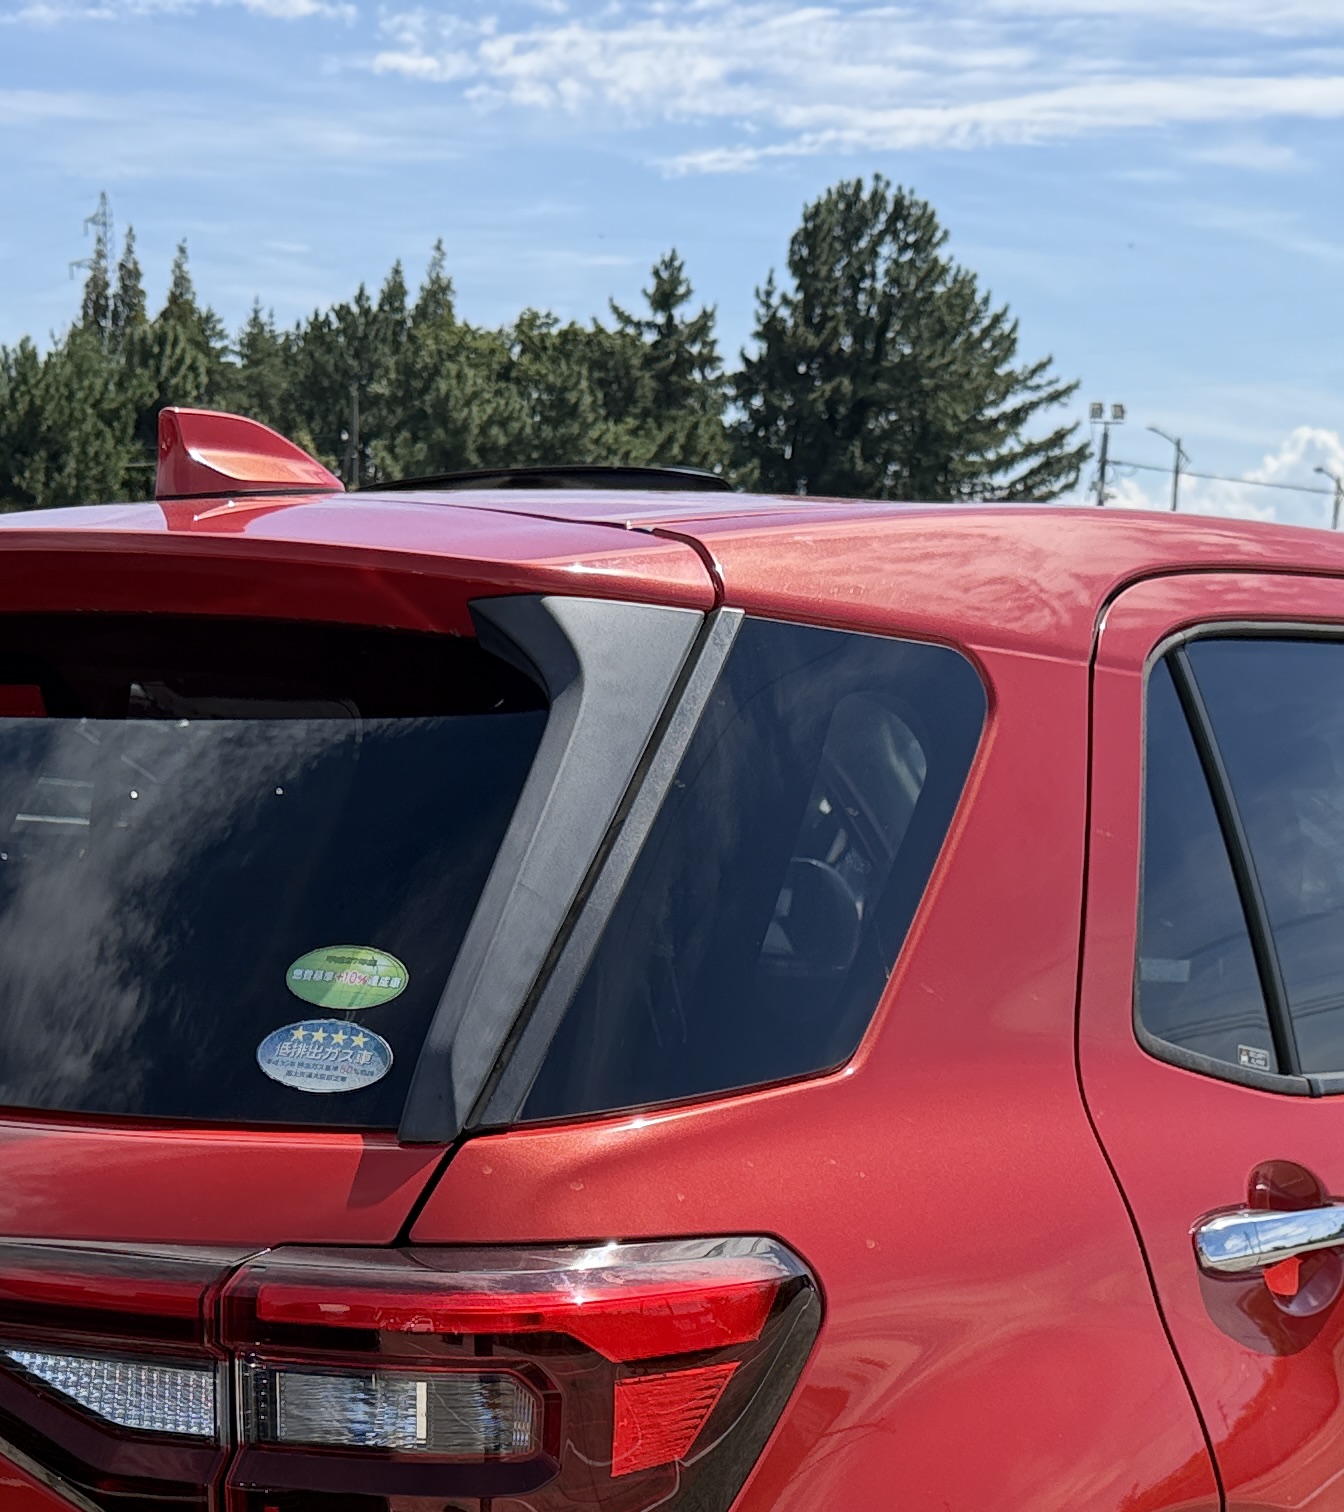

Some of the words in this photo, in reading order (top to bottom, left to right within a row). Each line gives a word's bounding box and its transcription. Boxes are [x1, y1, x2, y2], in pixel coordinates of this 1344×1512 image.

[275, 1041, 375, 1065] 低排出ガス車
